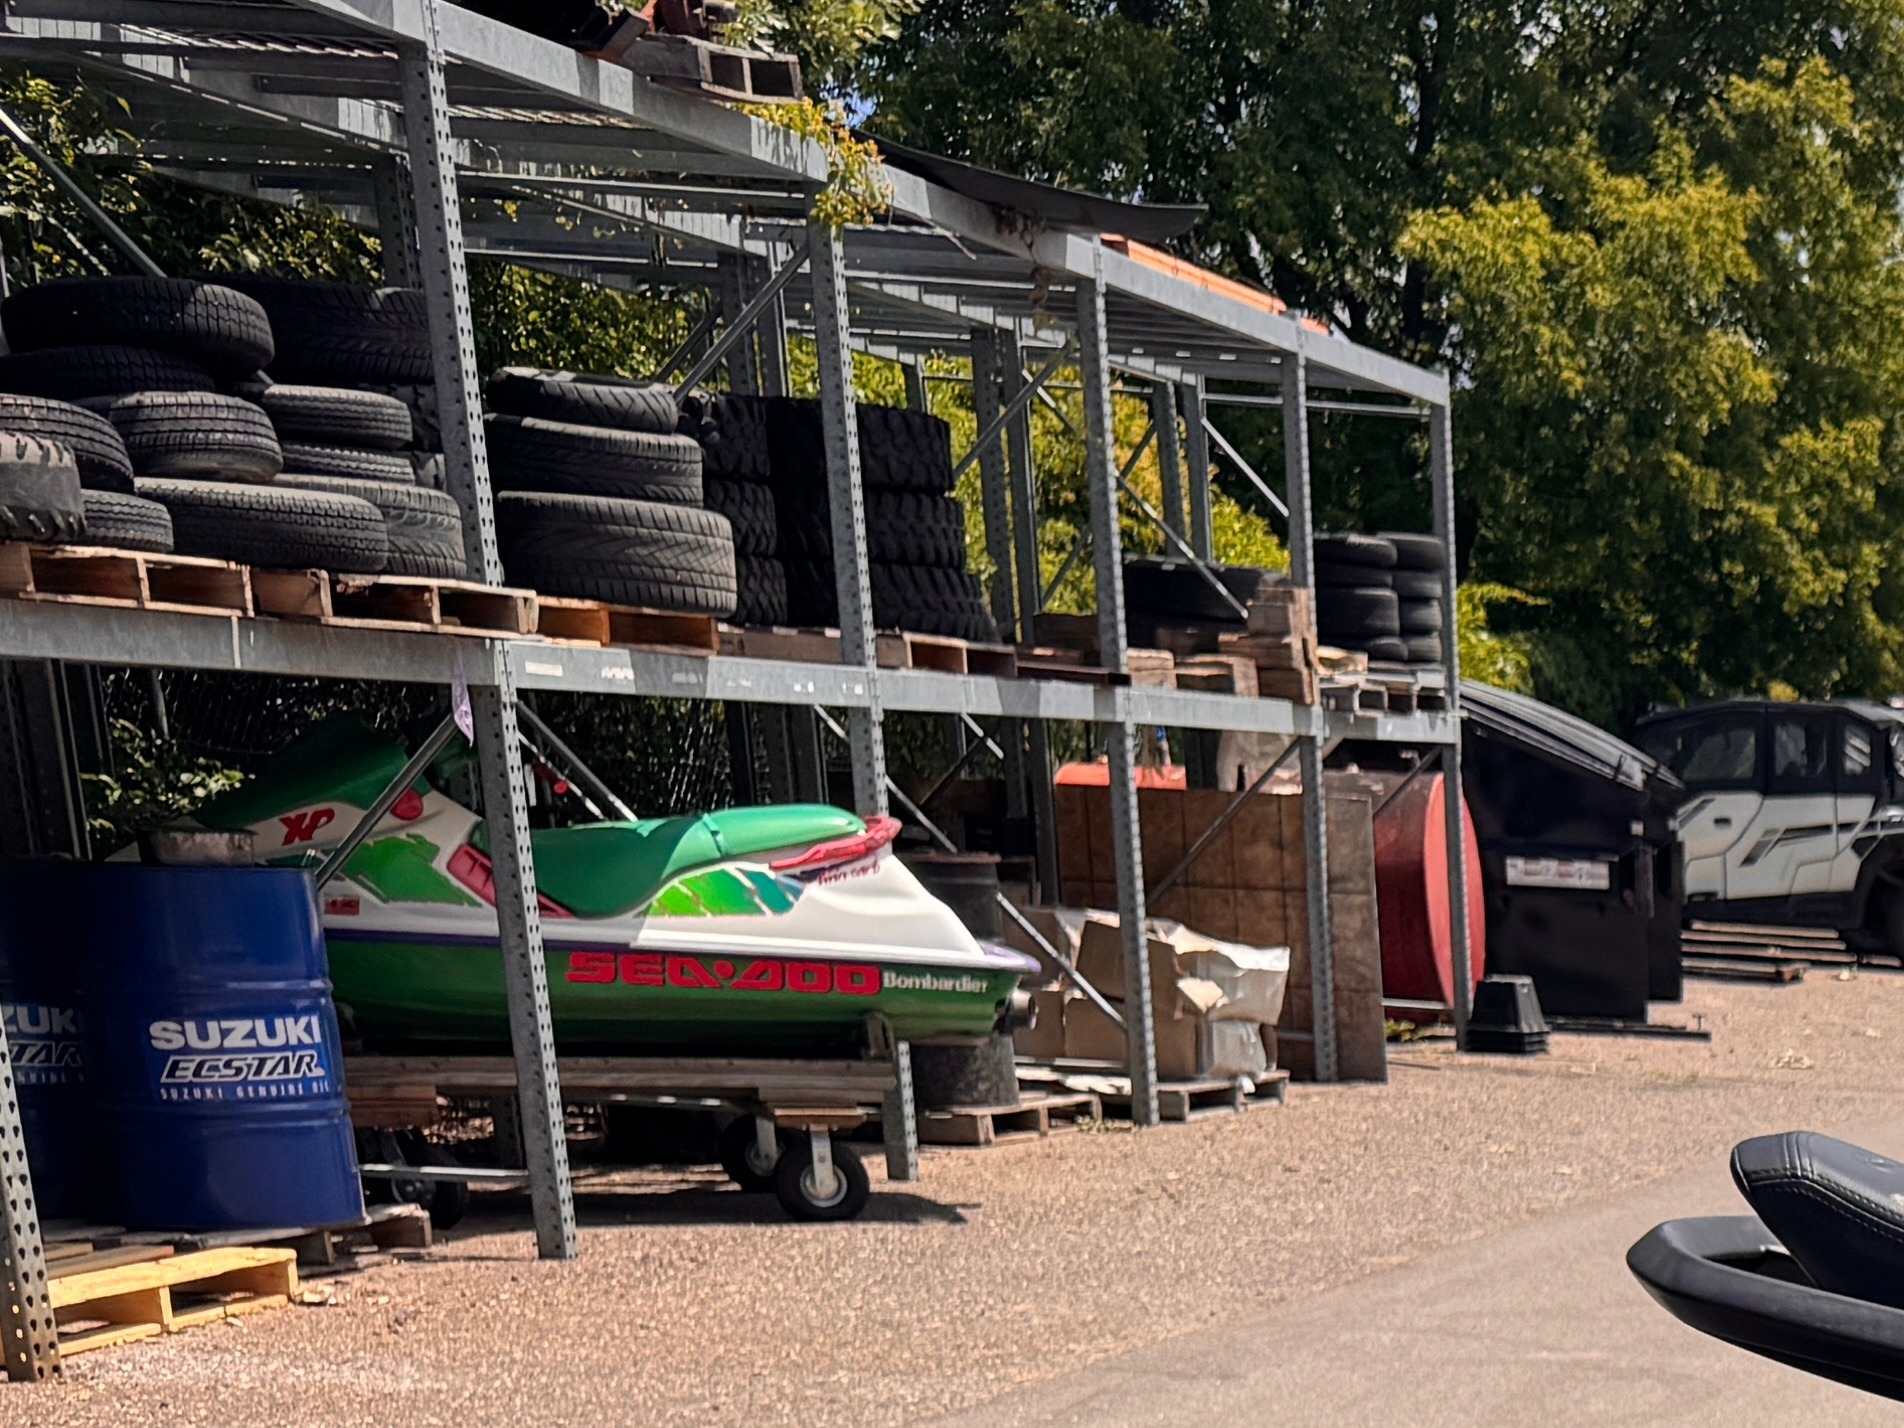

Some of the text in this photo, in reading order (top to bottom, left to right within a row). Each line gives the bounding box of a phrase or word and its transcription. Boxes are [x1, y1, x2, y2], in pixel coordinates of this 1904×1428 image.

[279, 808, 335, 846] XP
[883, 970, 989, 994] Bombardier
[150, 1015, 322, 1050] SUZUKI
[160, 1050, 325, 1083] ECSTAR
[160, 1087, 224, 1100] SUZUKI
